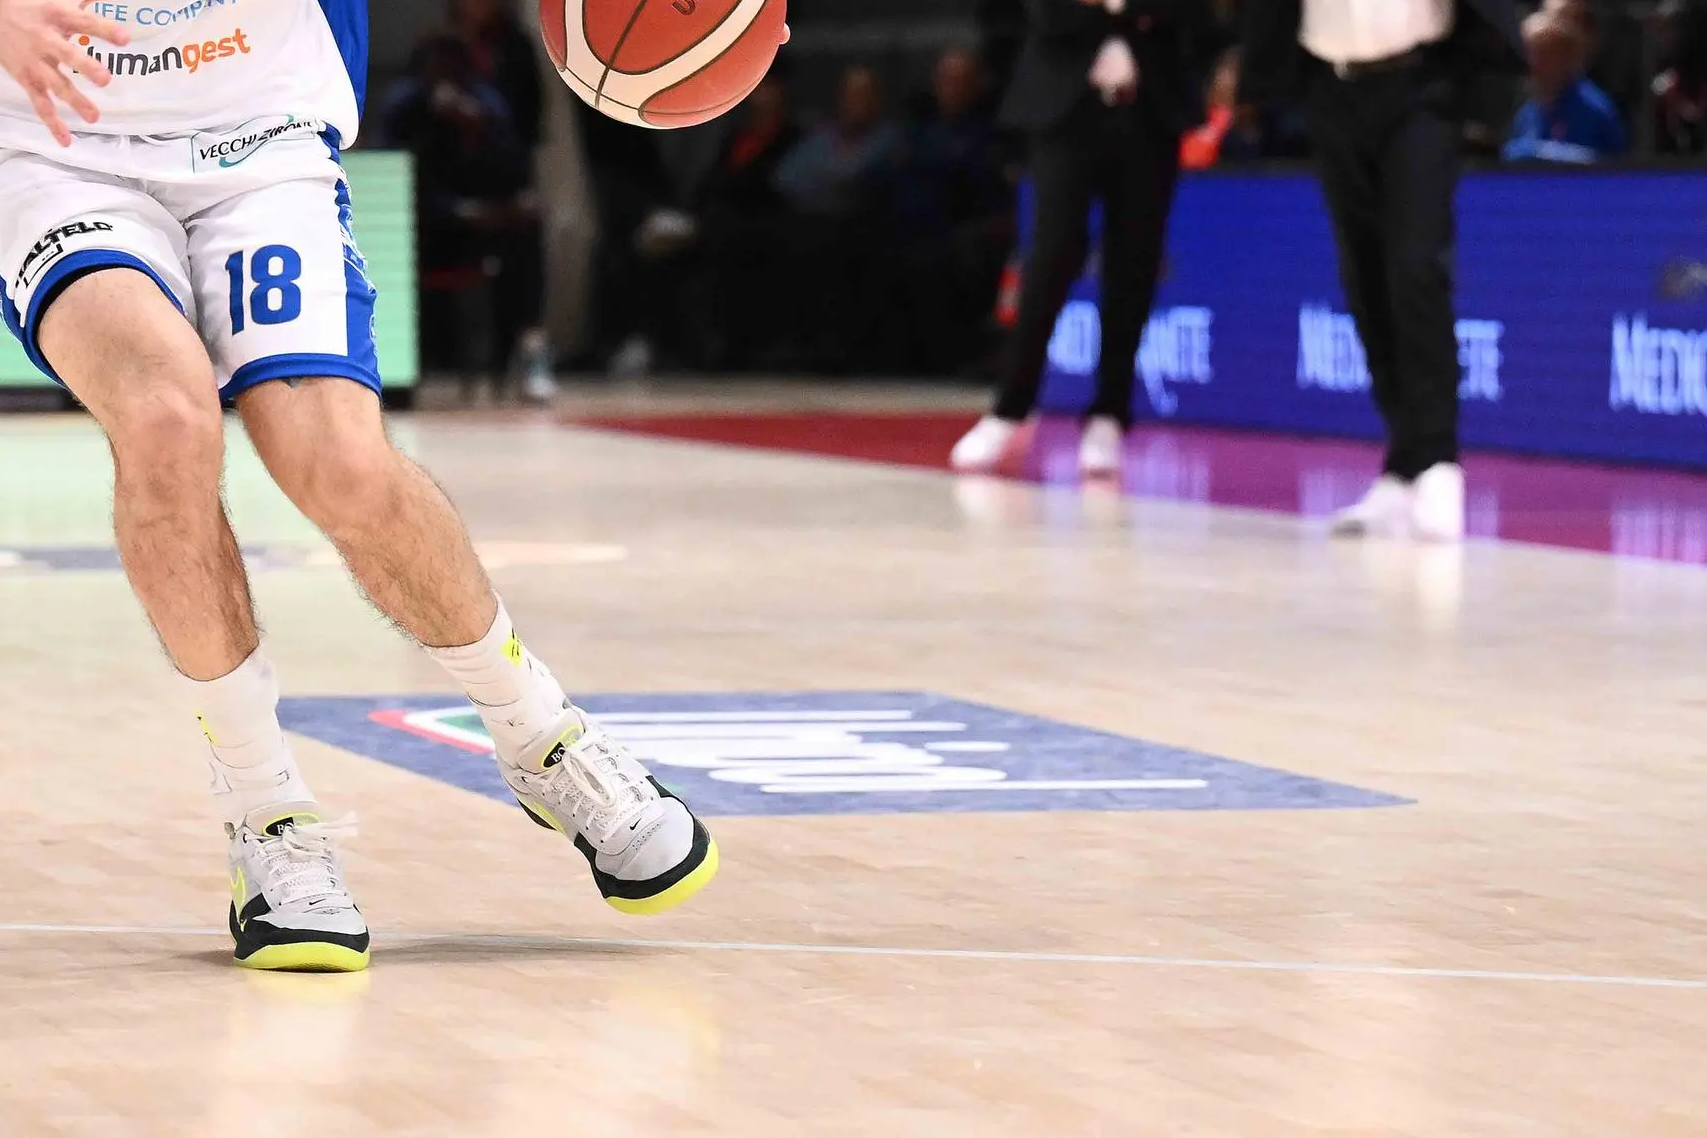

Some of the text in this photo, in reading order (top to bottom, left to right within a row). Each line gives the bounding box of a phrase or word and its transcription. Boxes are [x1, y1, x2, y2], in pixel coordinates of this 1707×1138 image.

[94, 2, 129, 22] IFE
[199, 134, 257, 160] VECCHI
[224, 244, 302, 337] 18
